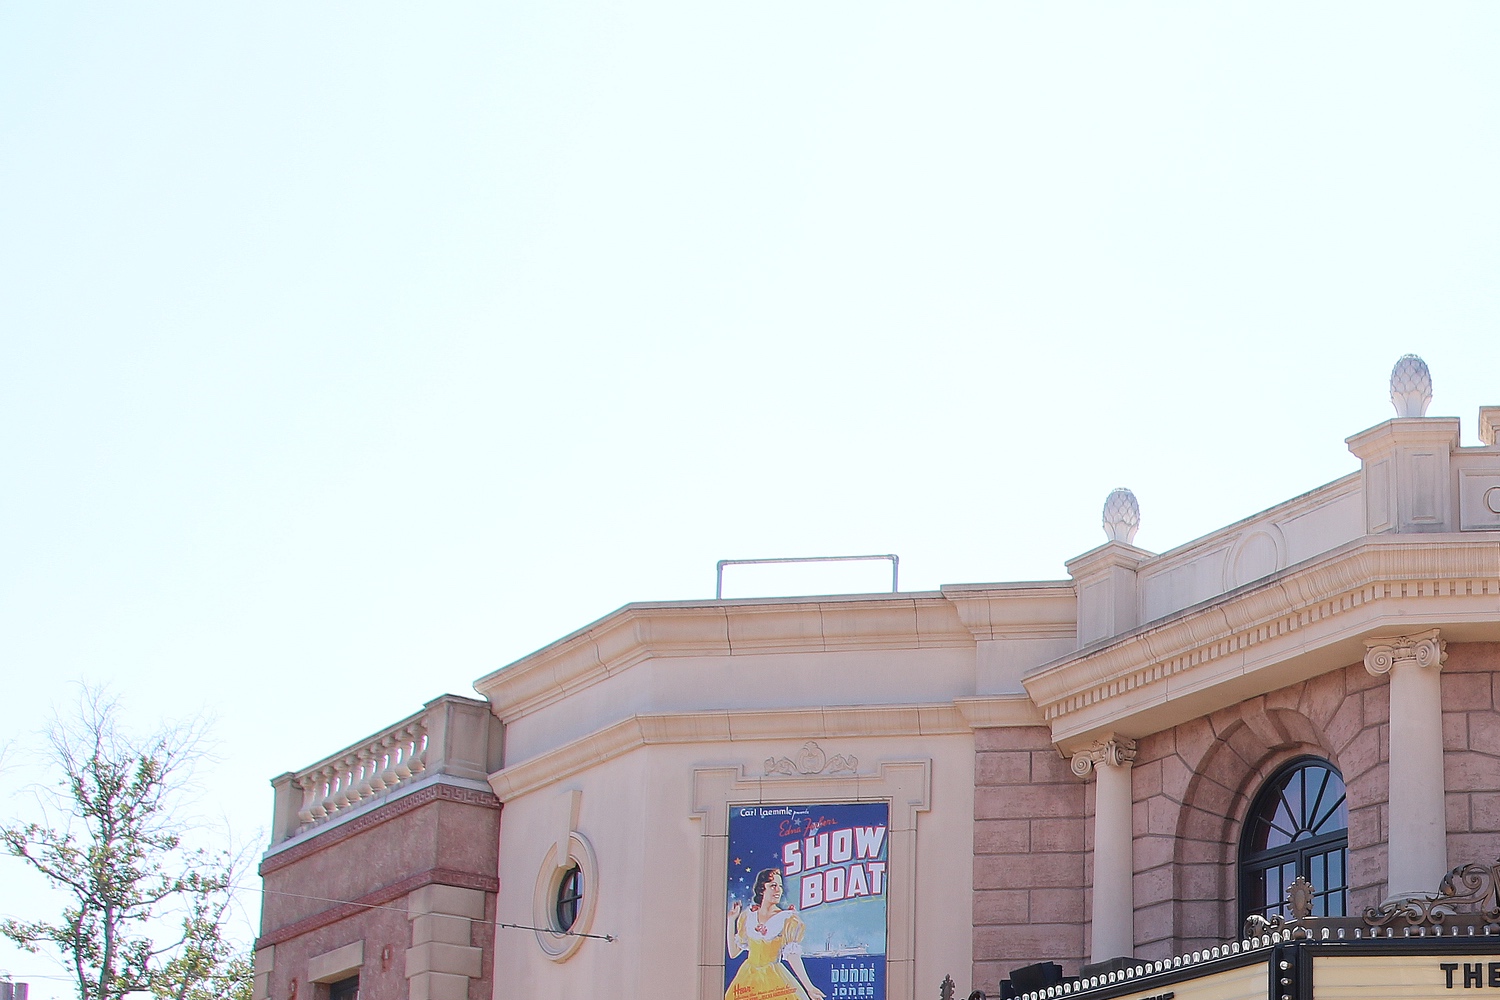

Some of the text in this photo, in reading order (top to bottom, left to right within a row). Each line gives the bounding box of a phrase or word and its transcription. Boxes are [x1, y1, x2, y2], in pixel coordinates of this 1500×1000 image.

[740, 808, 757, 817] Carl
[782, 825, 888, 877] SHOW
[800, 862, 886, 910] BOAT
[832, 986, 874, 996] JONES
